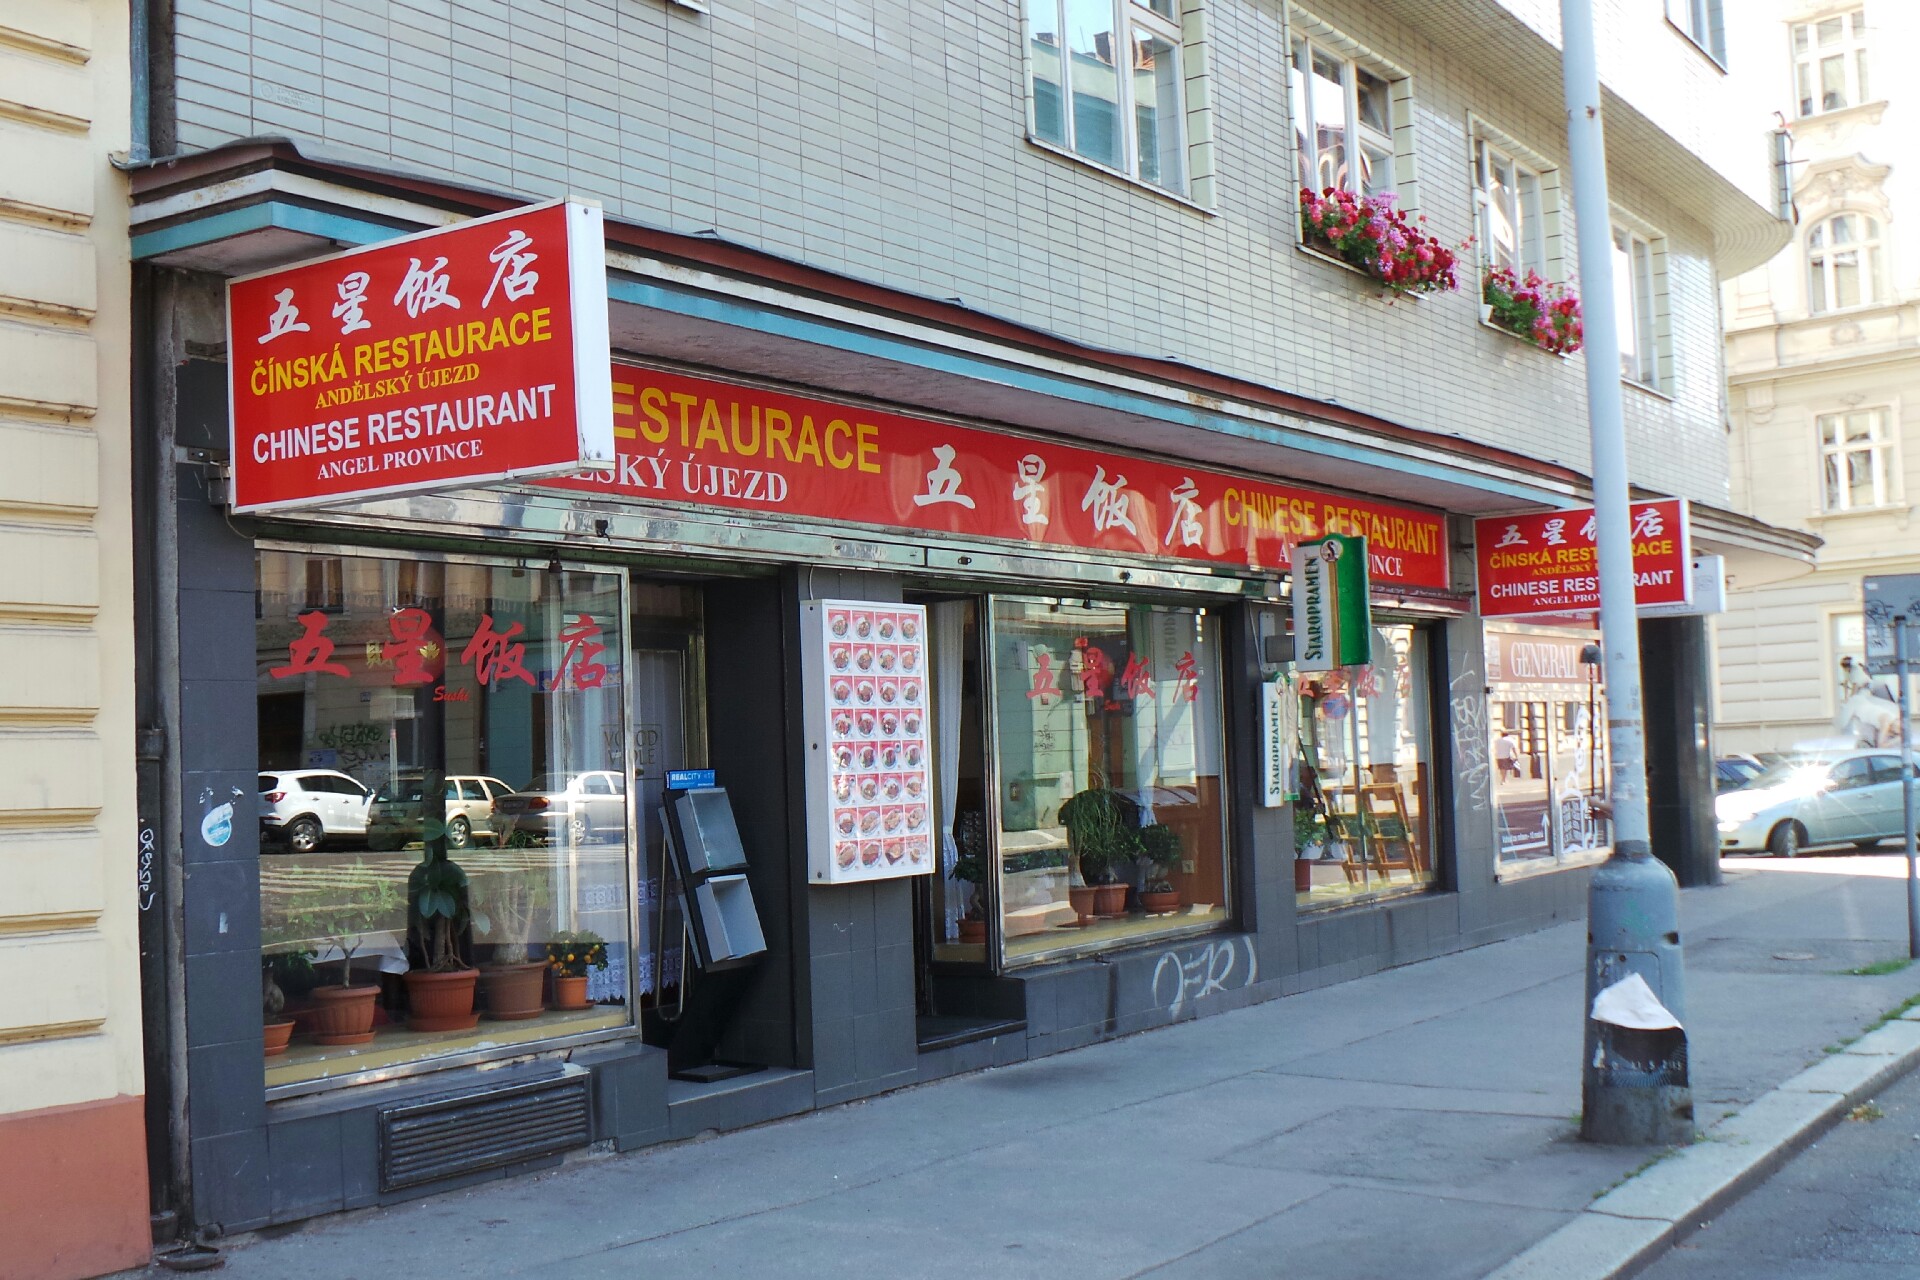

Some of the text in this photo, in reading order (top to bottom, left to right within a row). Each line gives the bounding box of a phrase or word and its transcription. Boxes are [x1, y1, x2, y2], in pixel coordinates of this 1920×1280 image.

[258, 229, 541, 344] 五星饭店
[250, 307, 552, 396] ČÍNSKÁ RESTAURACE
[314, 361, 480, 410] ANDĚLSKÝ ÚJEZD
[252, 383, 556, 464] CHINESE RESTAURANT
[317, 438, 483, 480] ANGEL PROVINCE
[680, 452, 788, 502] ÚJEZD
[913, 443, 1204, 547] 五星饭店
[1223, 487, 1316, 537] CHINESE
[1324, 504, 1438, 556] RESTAURANT
[1489, 548, 1551, 569] ČÍNSKÁ
[1532, 561, 1592, 577] ANDĚLSKÝ
[1303, 557, 1323, 661] STAROPRAMEN
[1490, 580, 1559, 598] CHINESE
[1532, 594, 1572, 606] ANGEL
[269, 608, 606, 692] 五星饭店
[1025, 647, 1200, 704] 五星饭店
[1510, 641, 1578, 680] GENERALI
[1270, 700, 1280, 795] STAROPRAMEN
